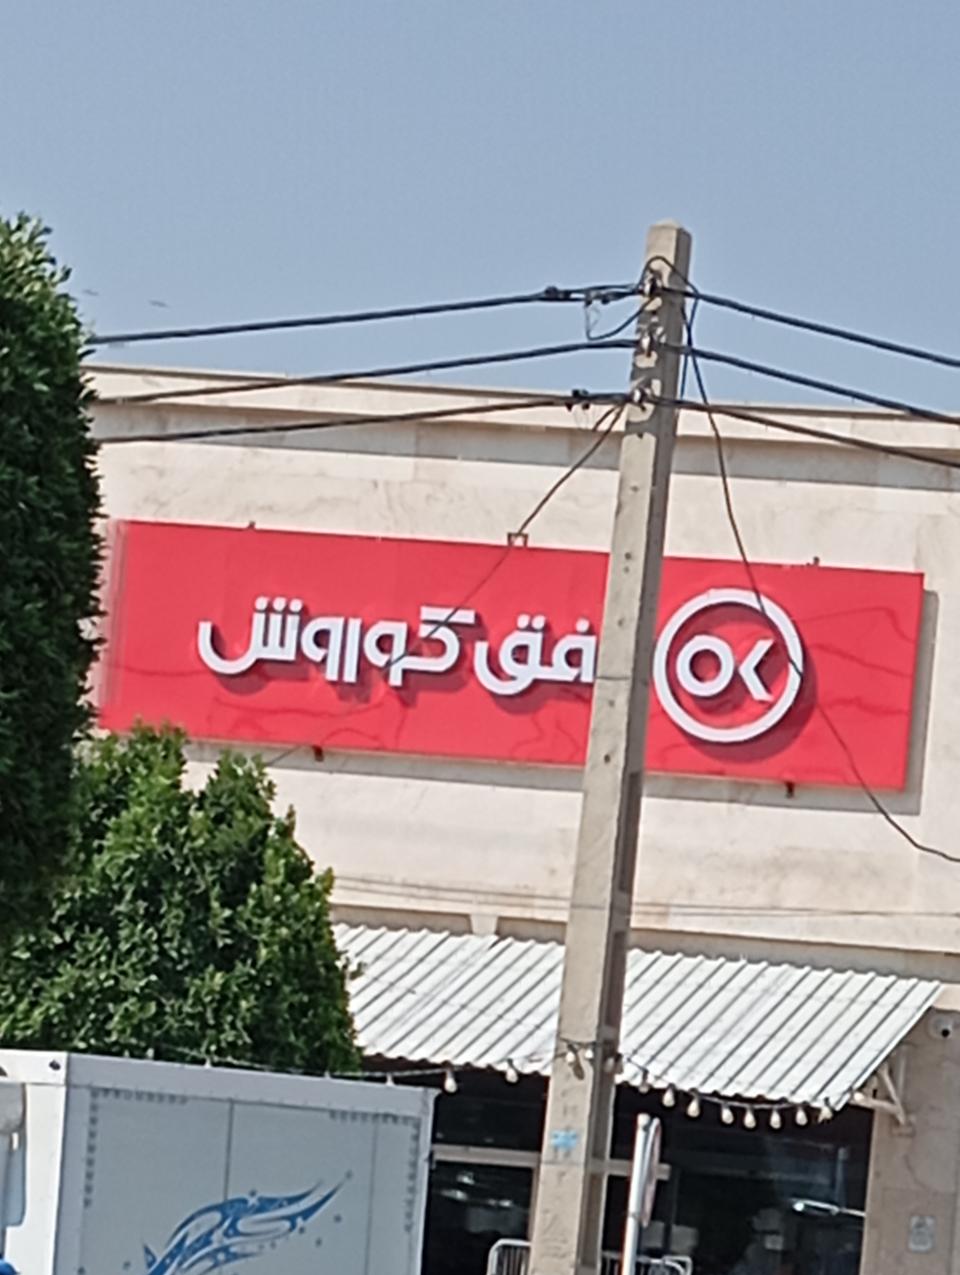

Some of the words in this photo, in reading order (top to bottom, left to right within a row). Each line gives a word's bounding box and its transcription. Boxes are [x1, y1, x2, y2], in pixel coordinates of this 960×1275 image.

[197, 595, 476, 687] کوروش
[473, 613, 597, 696] فق
[675, 633, 775, 703] OK
